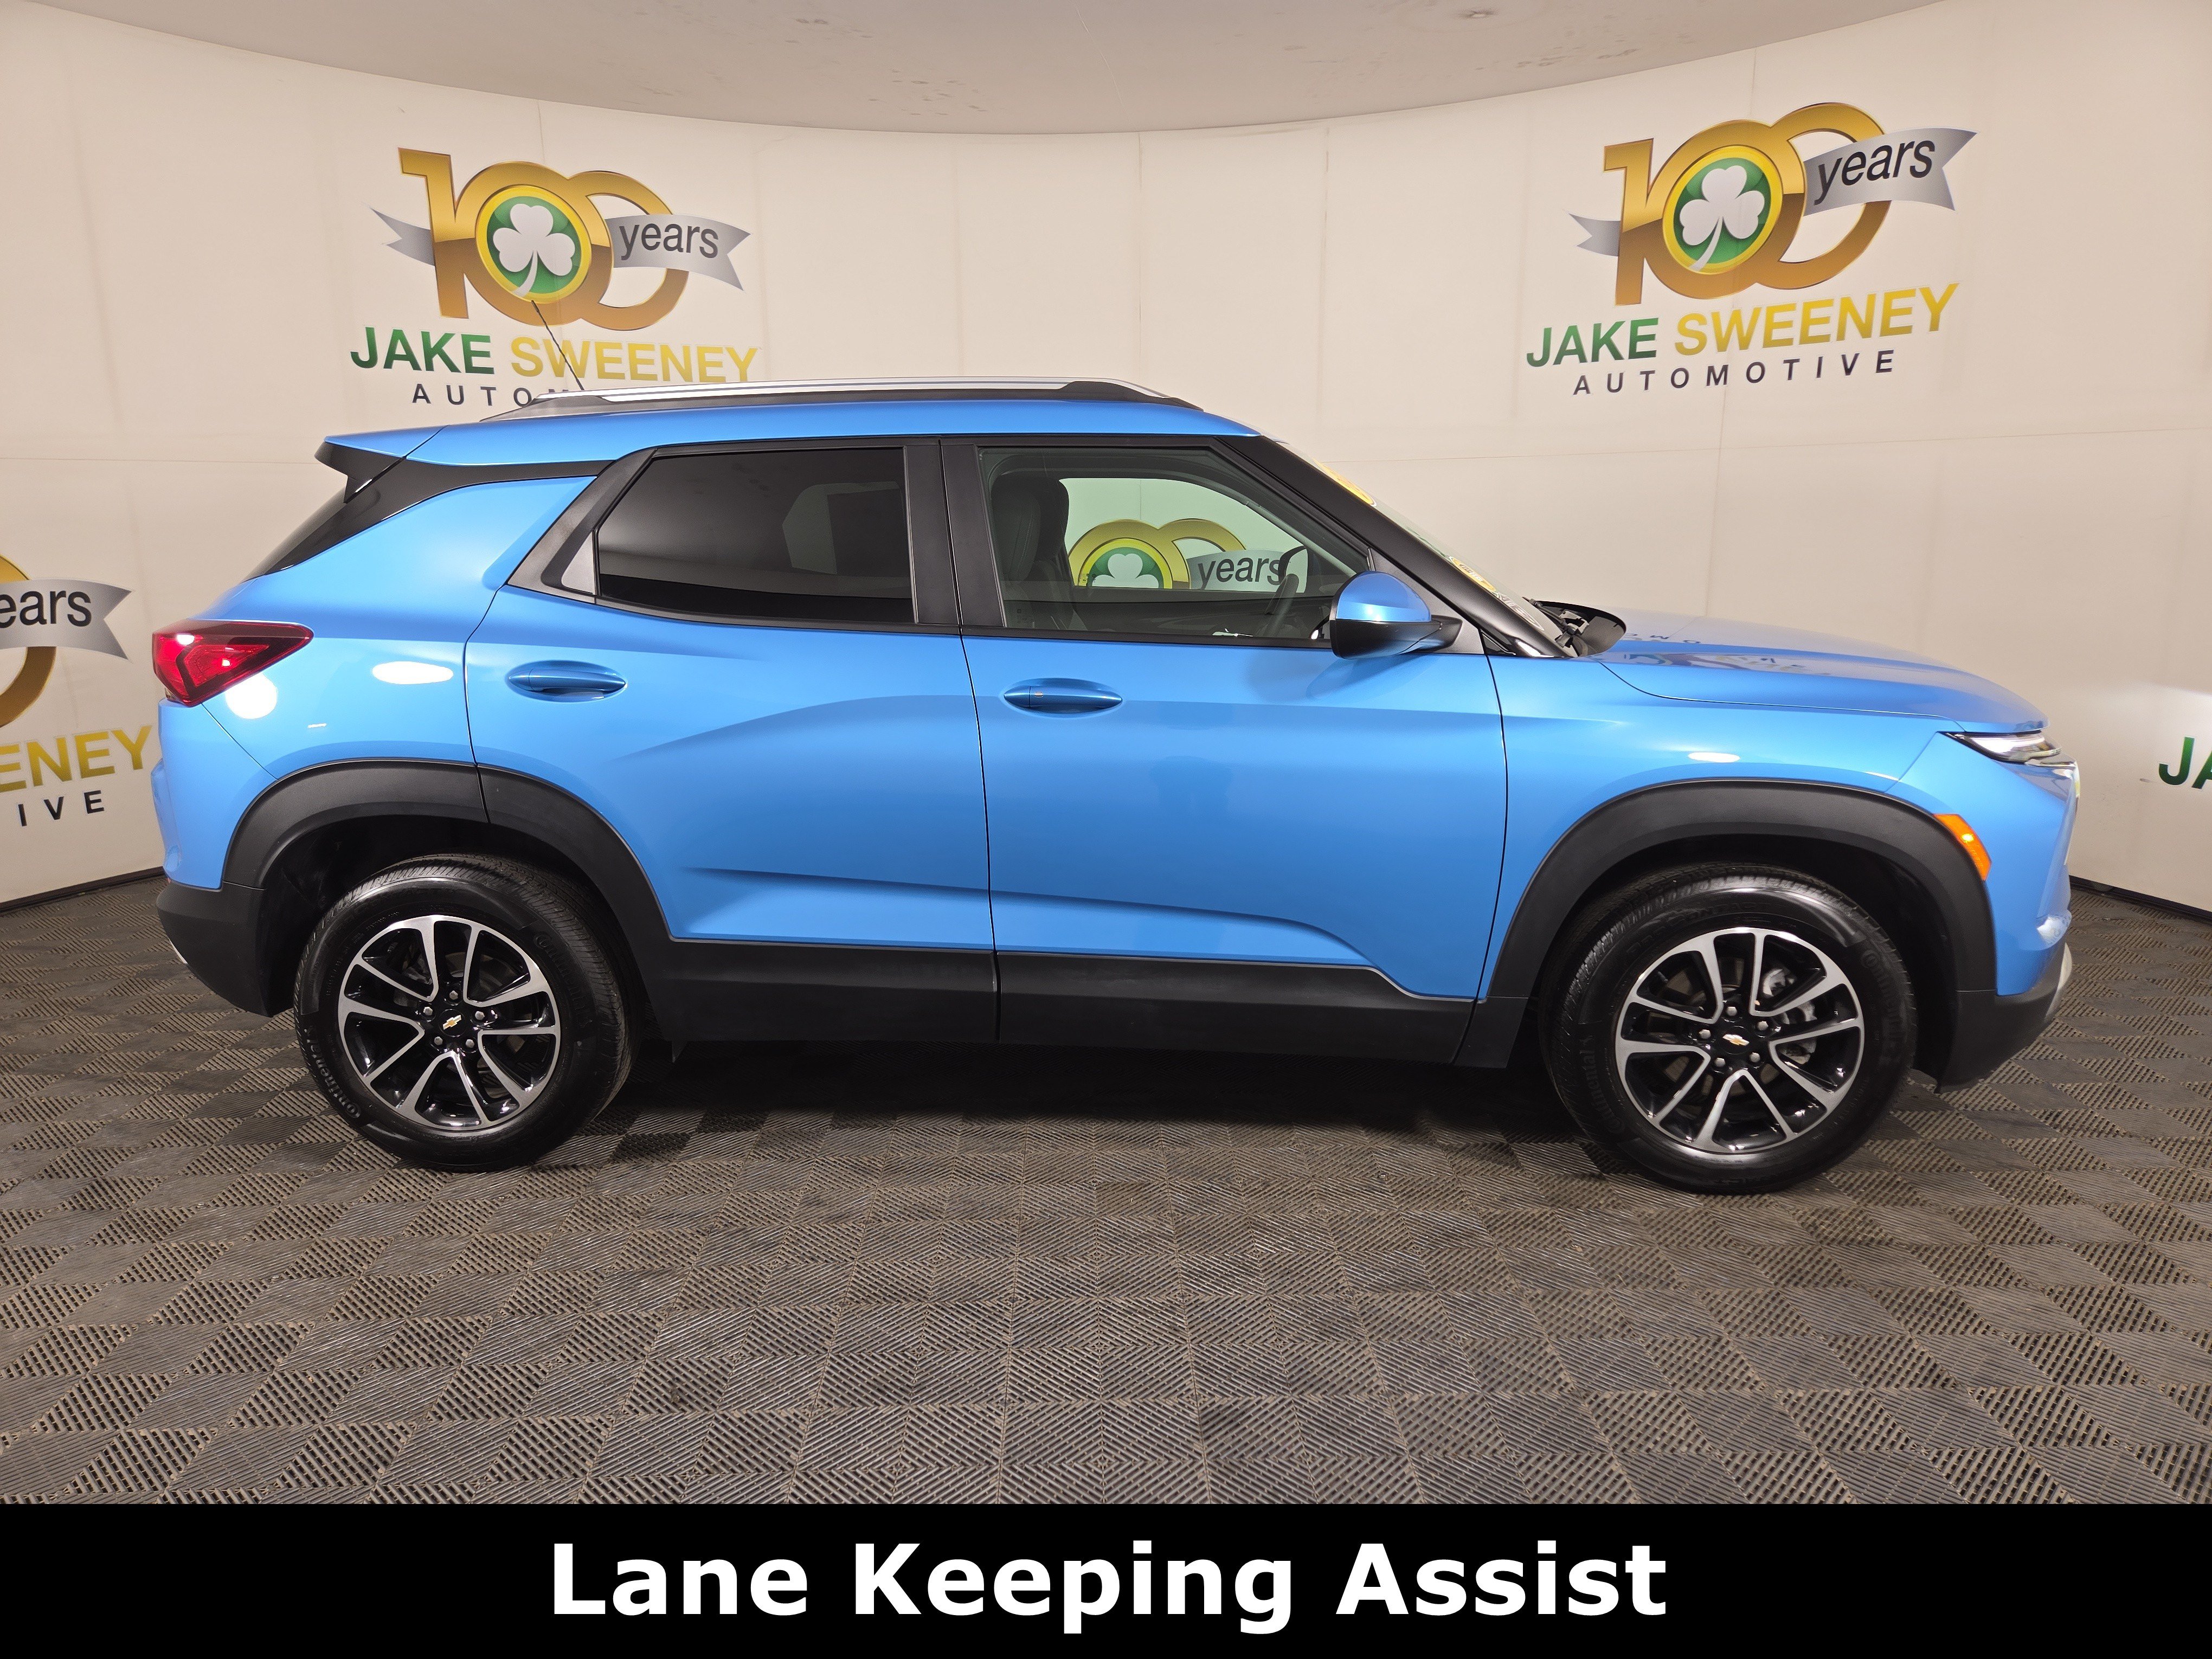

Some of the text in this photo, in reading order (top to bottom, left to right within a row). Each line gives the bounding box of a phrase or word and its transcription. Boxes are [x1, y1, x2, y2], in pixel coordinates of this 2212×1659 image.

[1814, 137, 1935, 205] years
[1603, 102, 1892, 307] 100
[397, 147, 689, 331] 100
[619, 223, 718, 260] years
[351, 327, 758, 383] JAKE SWEENEY
[1526, 283, 1959, 367] JAKE SWEENEY
[413, 383, 569, 407] AUTO
[1573, 350, 1895, 396] AUTOMOTIVE
